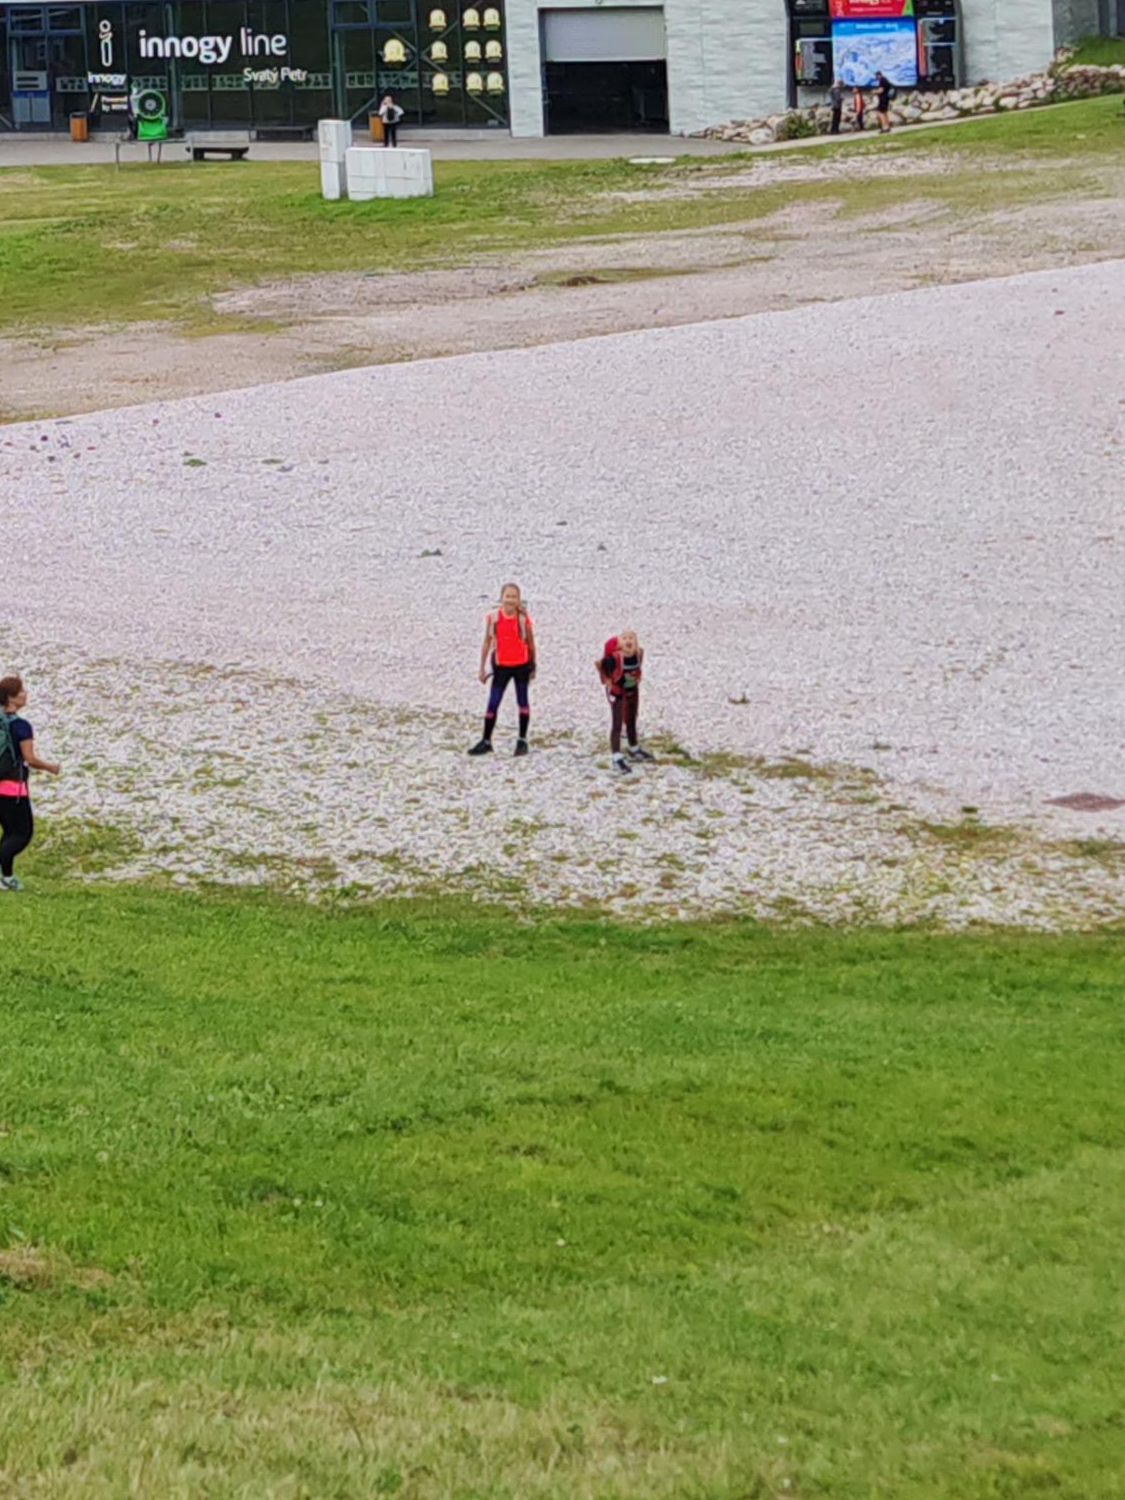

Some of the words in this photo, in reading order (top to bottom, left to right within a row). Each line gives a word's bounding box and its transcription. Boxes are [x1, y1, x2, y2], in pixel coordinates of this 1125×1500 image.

[139, 29, 232, 64] innogy
[240, 27, 287, 56] line
[87, 71, 127, 86] innogy
[243, 66, 279, 84] Svatý
[280, 67, 308, 82] Petr
